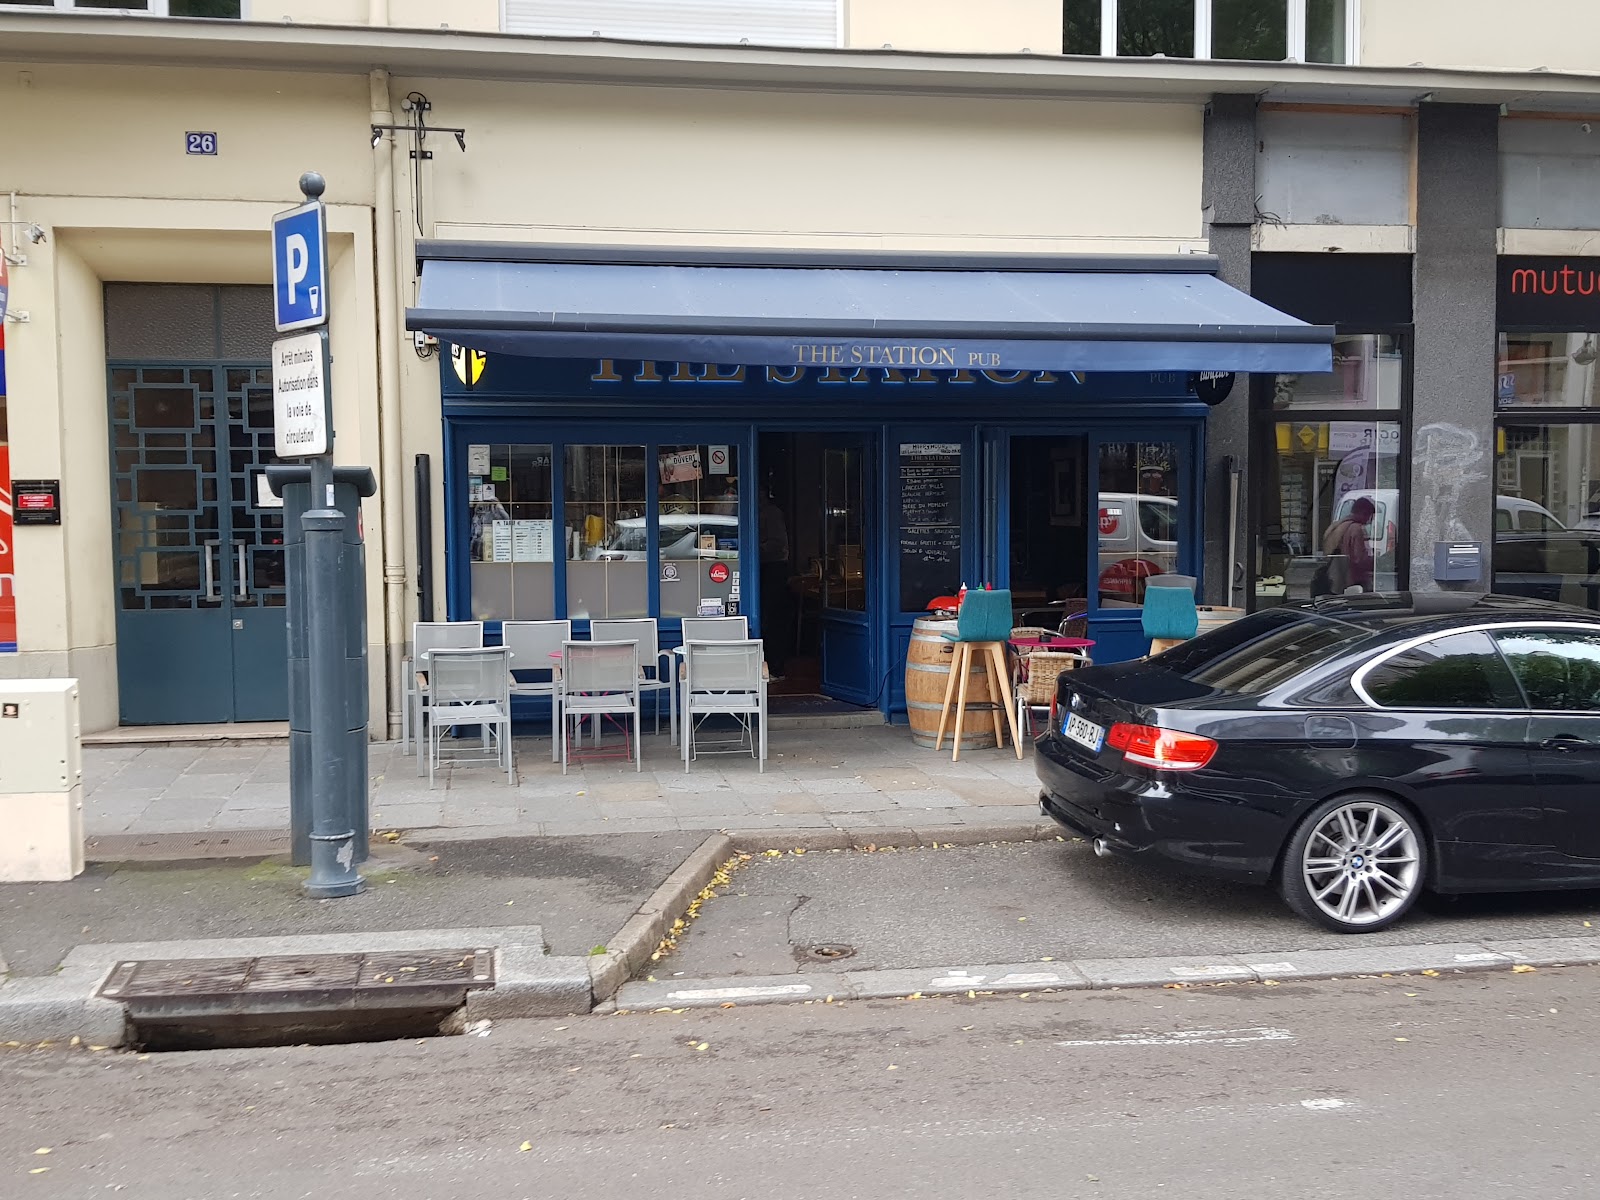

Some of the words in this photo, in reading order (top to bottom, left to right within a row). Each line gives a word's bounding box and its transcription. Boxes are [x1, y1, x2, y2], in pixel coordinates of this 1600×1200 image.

[189, 134, 213, 152] 26
[286, 233, 309, 305] P
[1511, 264, 1600, 295] mutu
[293, 347, 314, 365] minutes
[792, 345, 845, 364] THE
[850, 346, 956, 366] STATION
[967, 352, 1001, 366] PUB
[278, 376, 307, 394] Autorisation
[307, 374, 319, 392] dans
[1150, 372, 1176, 384] PUB
[286, 402, 292, 419] la
[292, 401, 305, 418] voie
[305, 400, 313, 416] de
[285, 427, 315, 445] circulation
[673, 454, 696, 465] OUVERT
